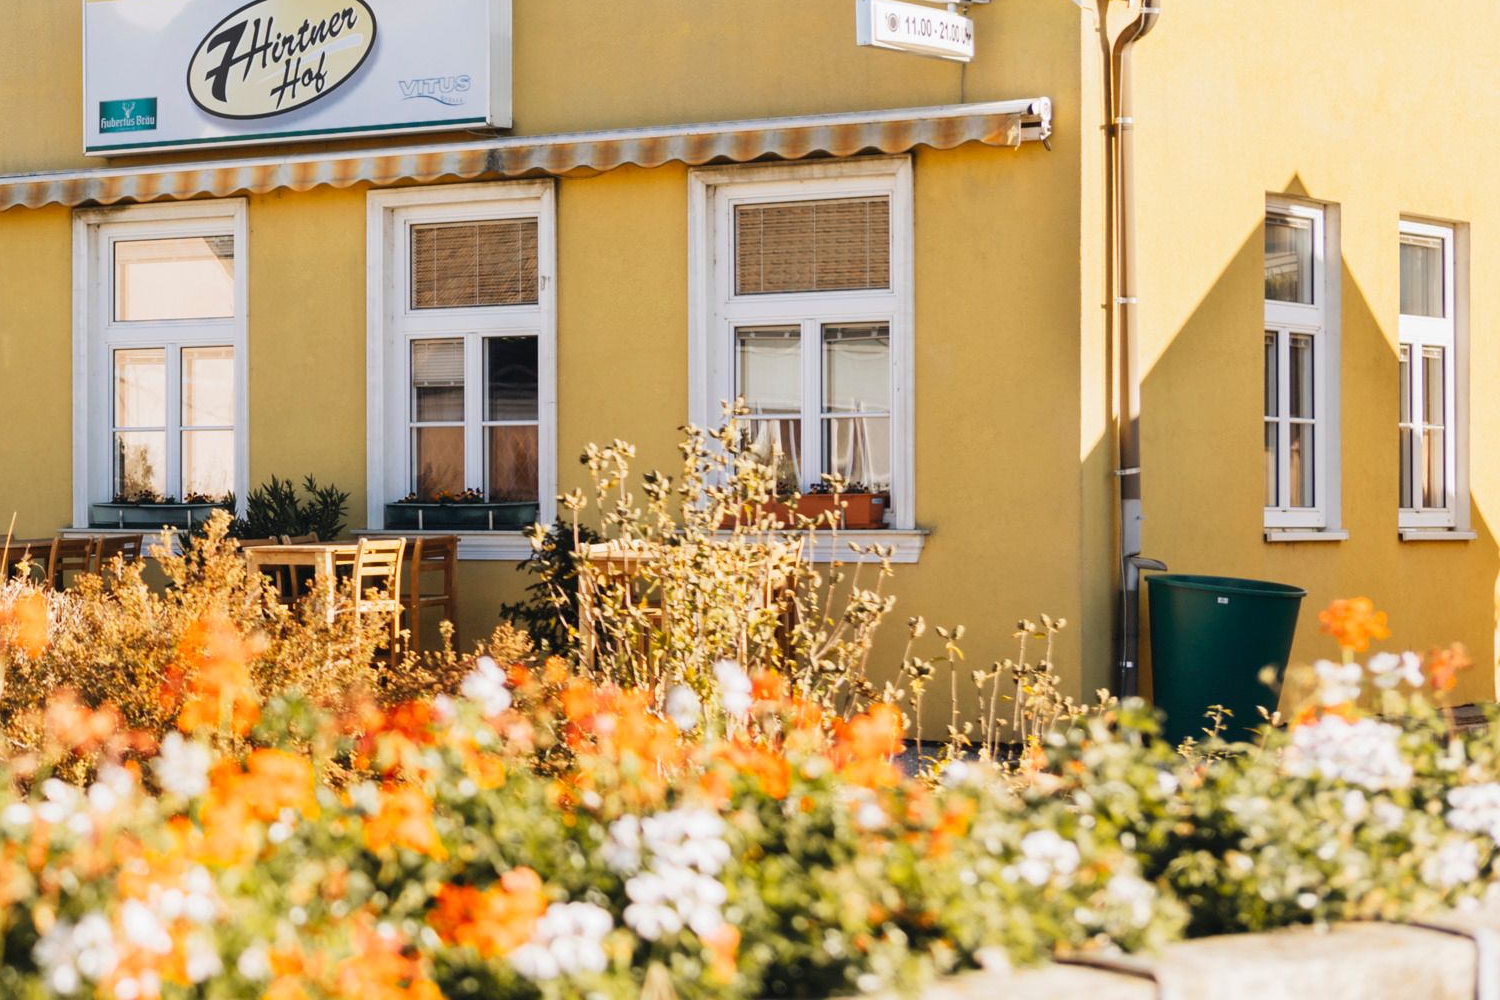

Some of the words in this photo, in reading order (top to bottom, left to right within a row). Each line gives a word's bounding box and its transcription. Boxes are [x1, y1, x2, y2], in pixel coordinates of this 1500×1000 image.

[905, 15, 932, 38] 11.00
[939, 21, 960, 43] 21.00
[270, 49, 328, 110] Hof
[398, 74, 471, 97] VITUS
[100, 116, 136, 129] Hubertus
[136, 114, 155, 126] Bräu
